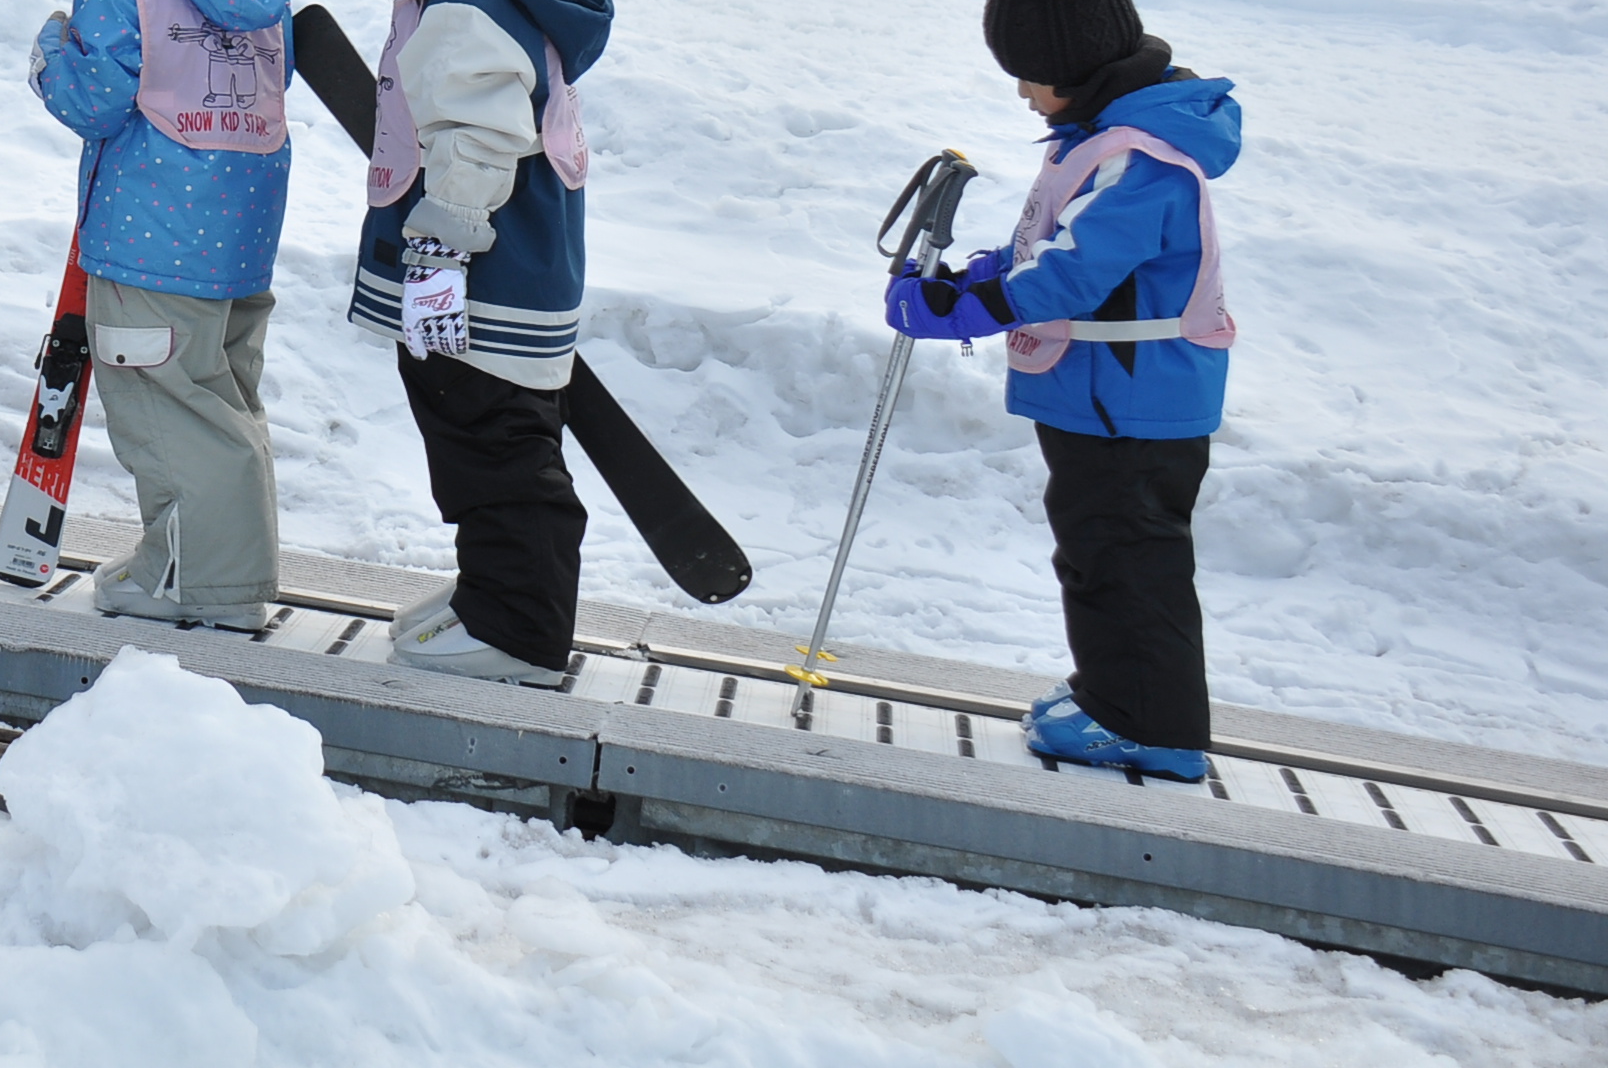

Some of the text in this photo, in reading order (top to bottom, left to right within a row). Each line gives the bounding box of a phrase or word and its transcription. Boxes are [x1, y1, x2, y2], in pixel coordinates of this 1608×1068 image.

[177, 110, 213, 133] SNOW
[221, 110, 240, 132] KID
[24, 504, 66, 548] J
